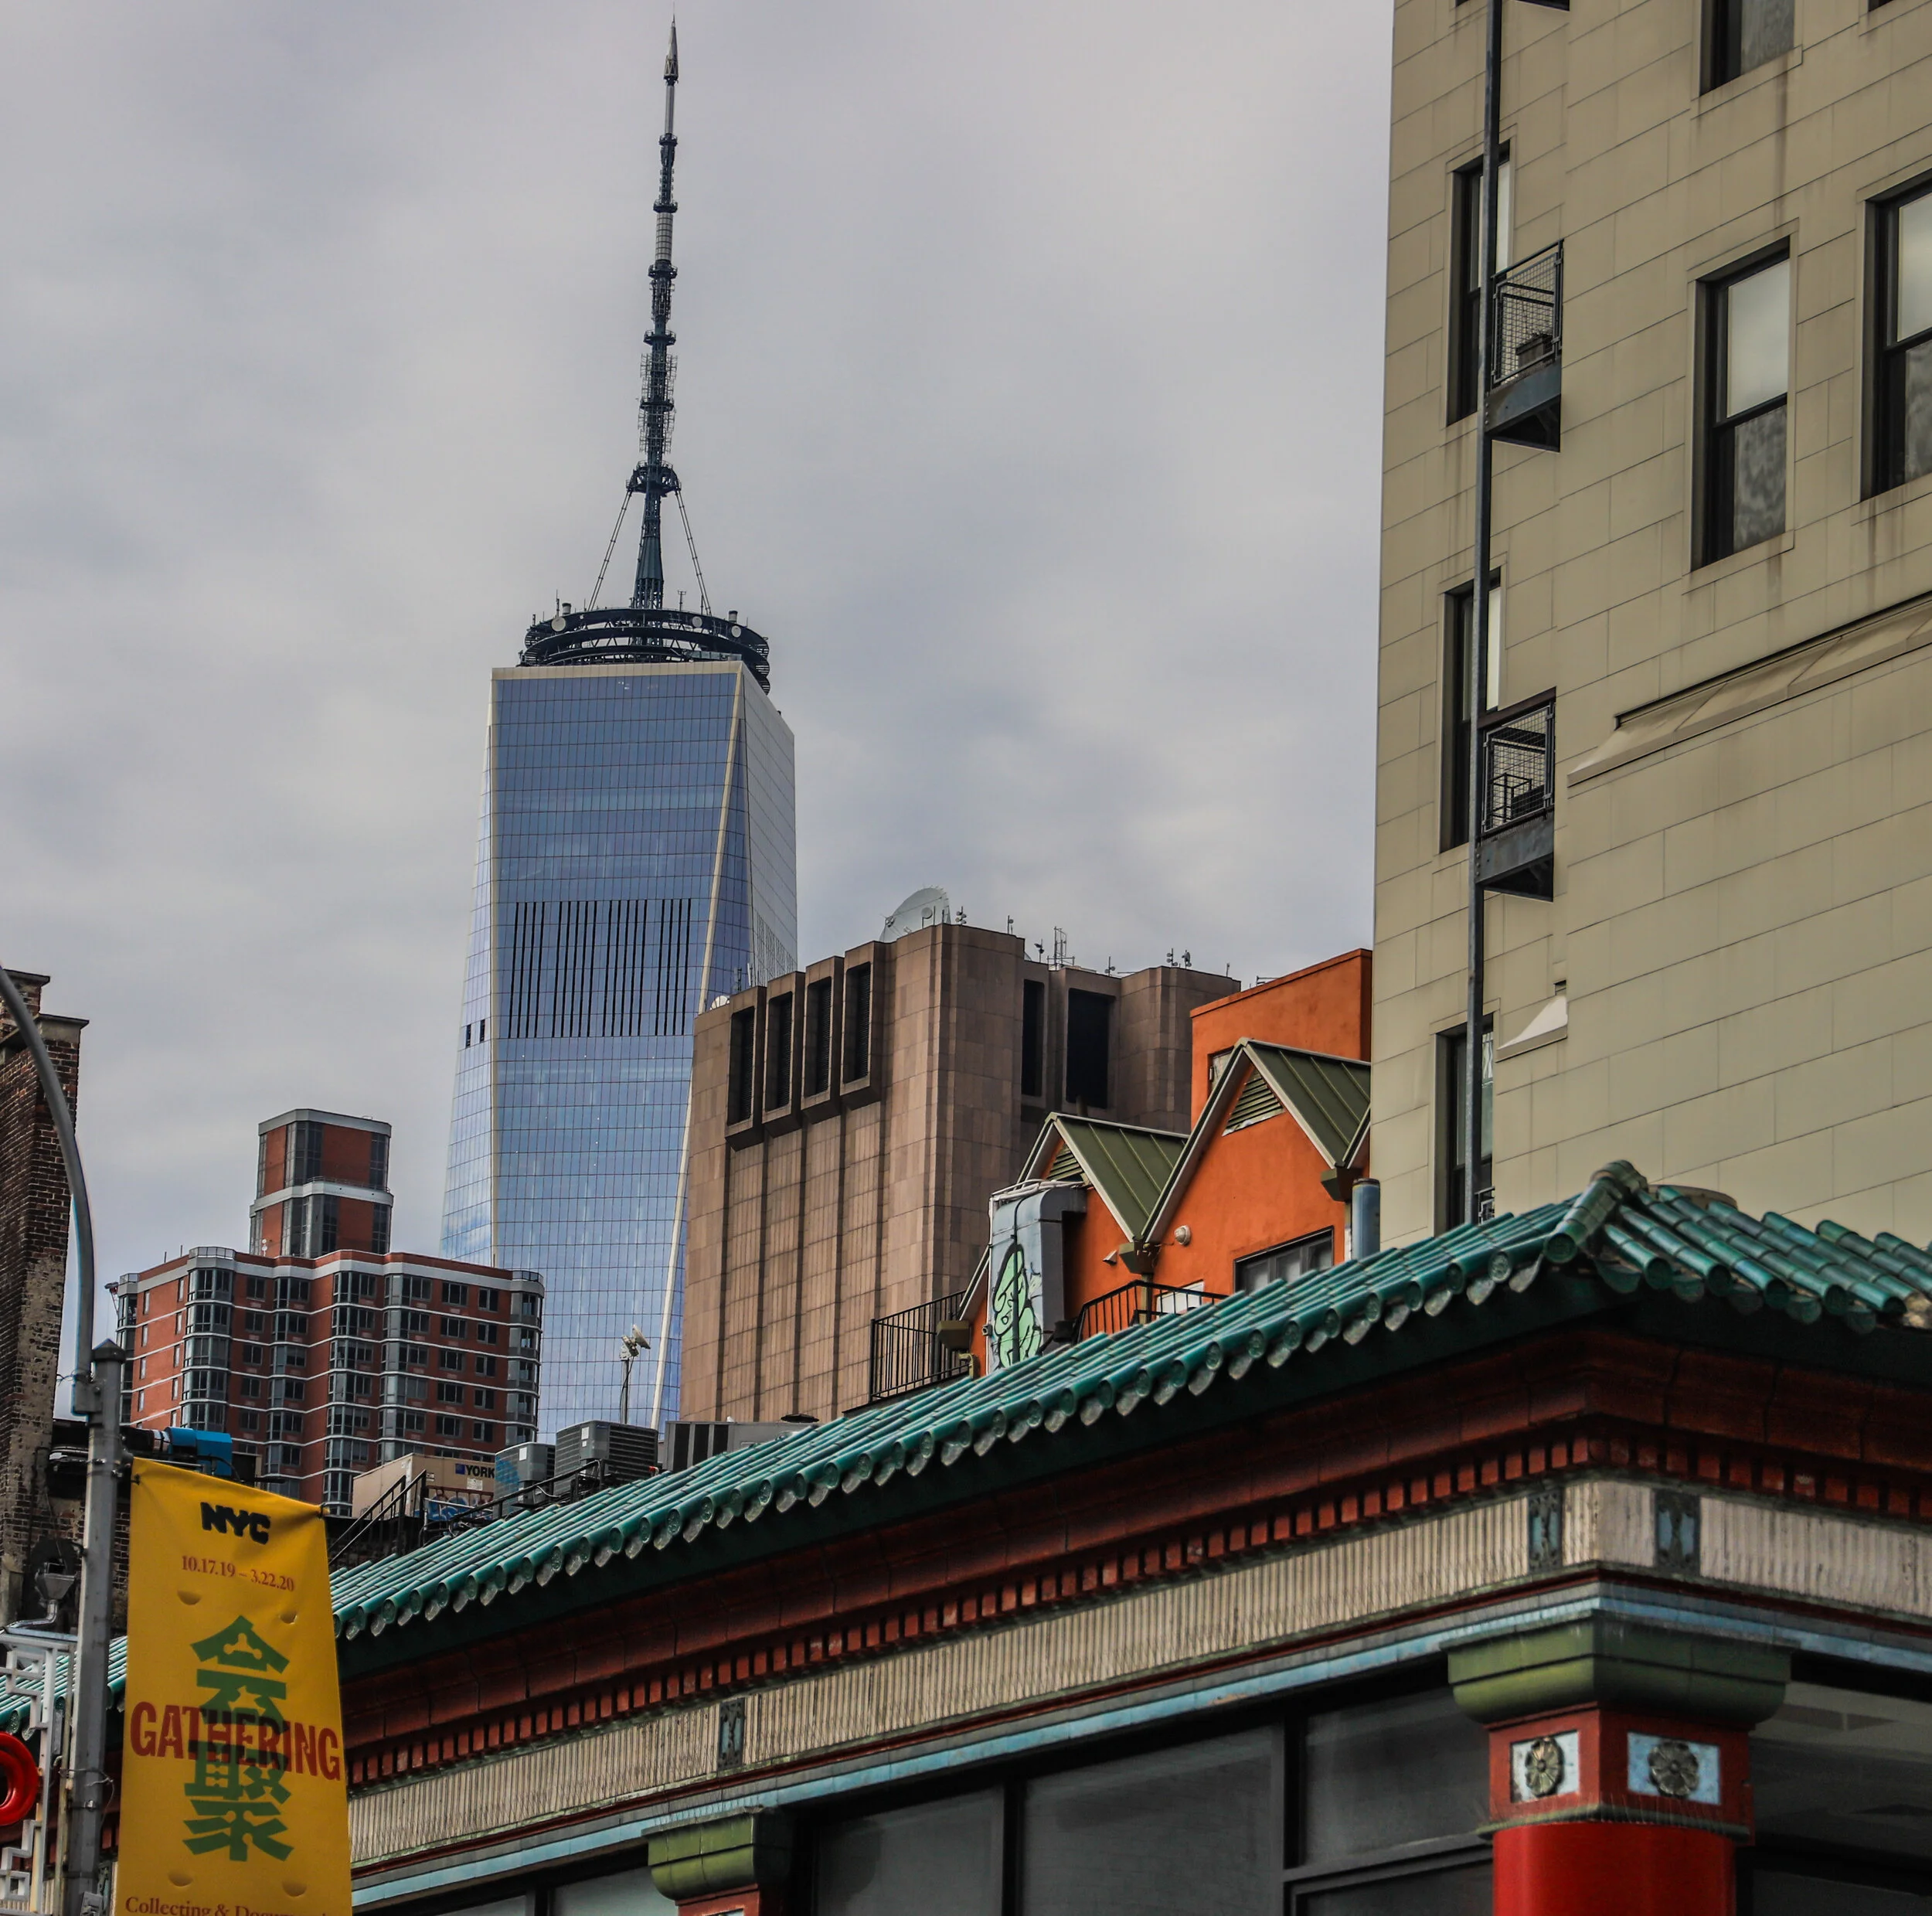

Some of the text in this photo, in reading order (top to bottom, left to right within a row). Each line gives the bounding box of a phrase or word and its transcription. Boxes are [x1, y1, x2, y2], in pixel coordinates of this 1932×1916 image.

[465, 1465, 495, 1479] YORK
[200, 1502, 270, 1545] NYC
[182, 1555, 236, 1577] 10.17.19
[250, 1569, 295, 1592] 3.22.20
[130, 1701, 341, 1781] GATHERING
